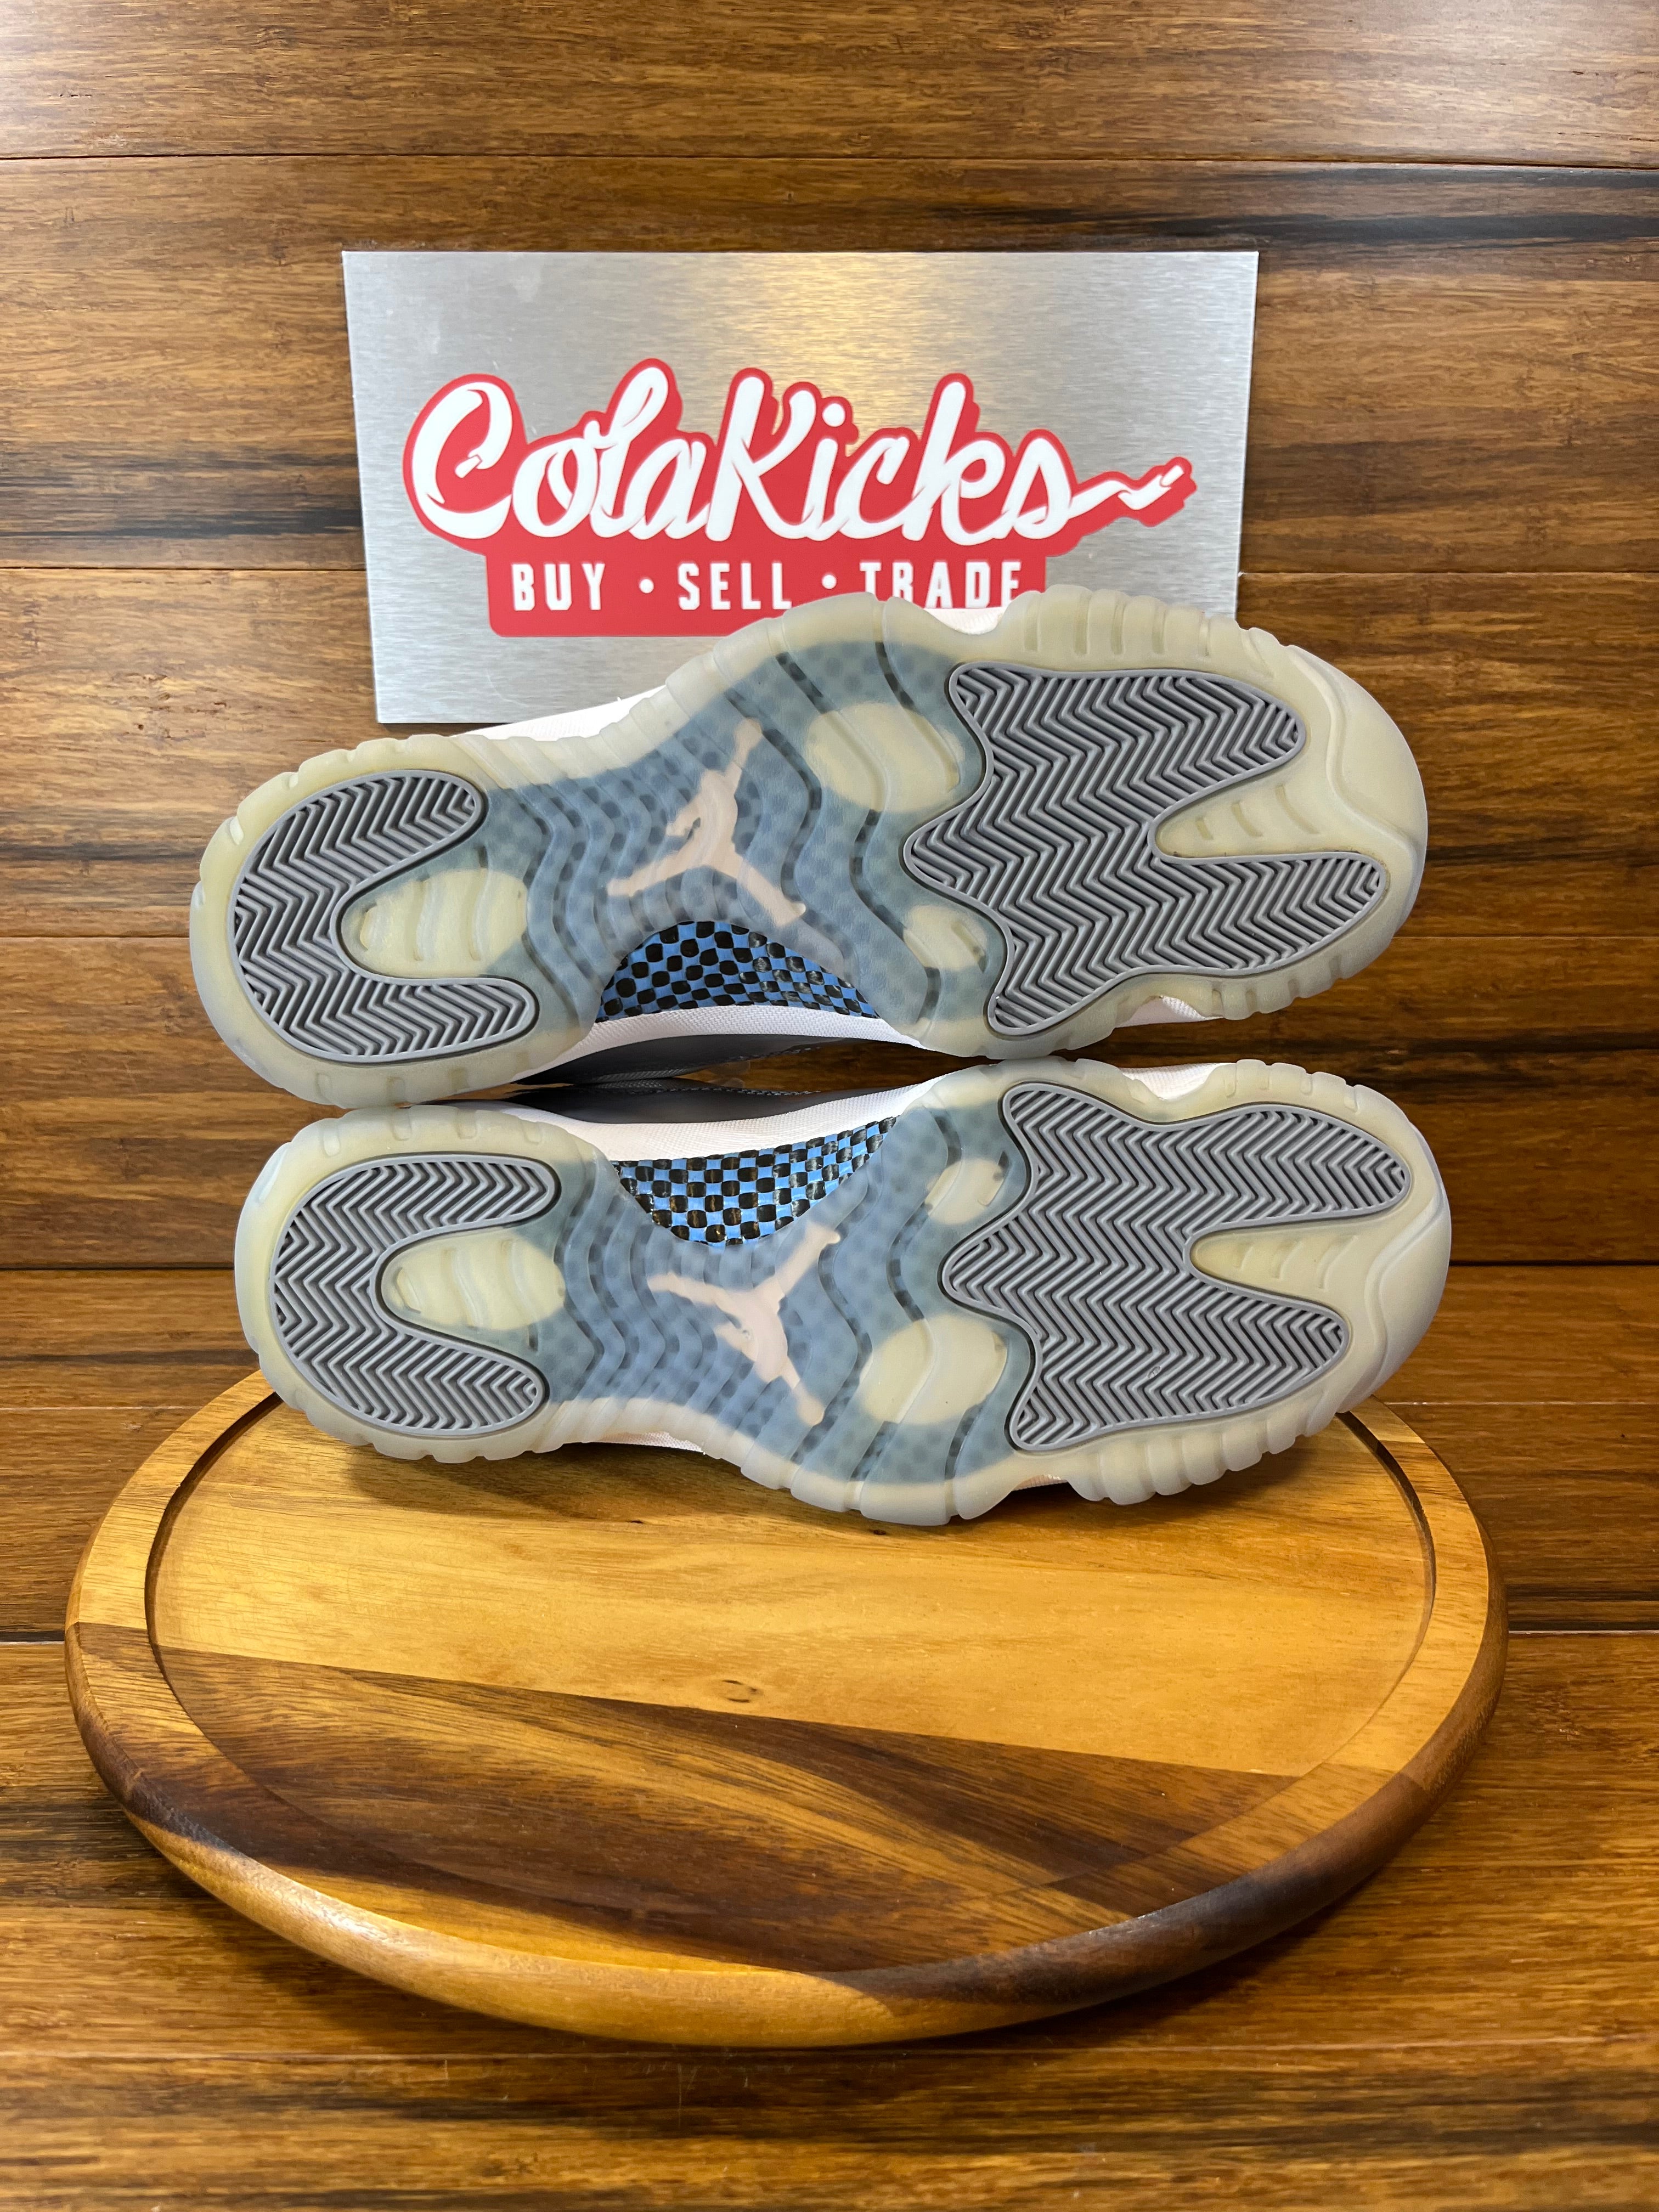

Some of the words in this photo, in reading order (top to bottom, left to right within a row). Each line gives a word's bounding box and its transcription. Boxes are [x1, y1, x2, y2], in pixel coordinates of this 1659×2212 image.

[511, 563, 605, 611] BUY
[678, 562, 793, 610] SELL
[860, 561, 1022, 609] TRADE
